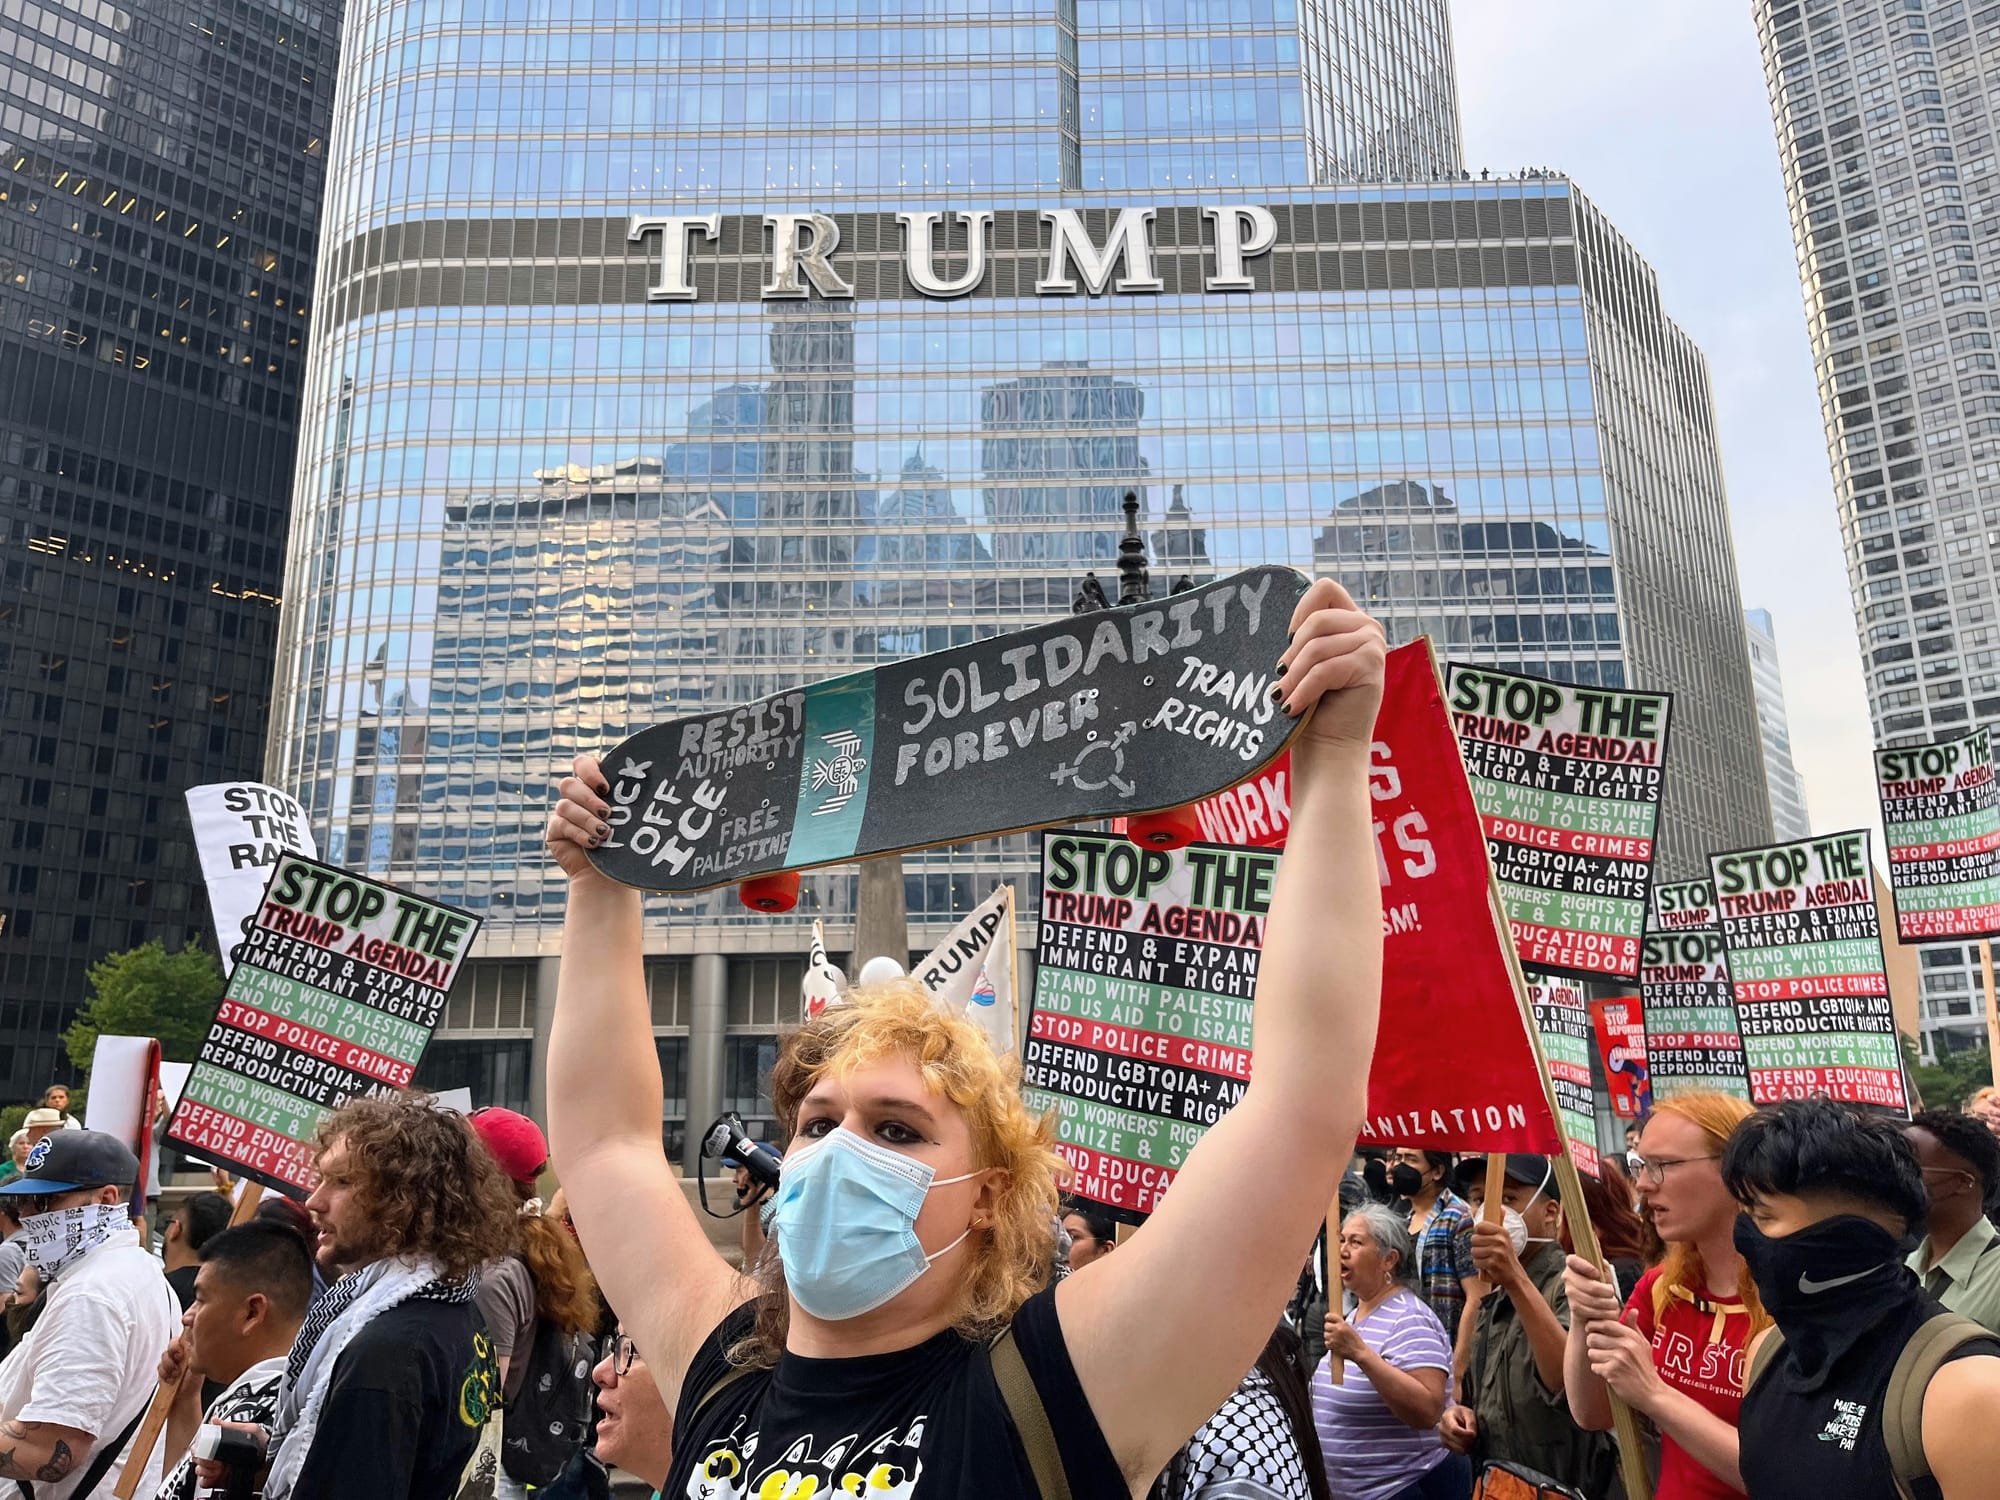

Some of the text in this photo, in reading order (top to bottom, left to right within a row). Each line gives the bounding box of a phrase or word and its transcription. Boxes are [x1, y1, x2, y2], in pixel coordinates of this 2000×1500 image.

[627, 206, 1278, 301] TRUMP
[903, 573, 1272, 734] SOLIDARITY
[1176, 656, 1278, 725] TRANS
[1452, 671, 1660, 739] STOP THE
[678, 693, 806, 757] RESIST
[895, 688, 1099, 786] FOREVER
[1154, 698, 1263, 761] RIGHTS
[1537, 727, 1656, 763] AGENDA!
[675, 734, 801, 780] AUTHORITY
[801, 756, 811, 799] HABITAT
[1460, 740, 1660, 785] EFEND & EXPAND
[224, 787, 298, 821] STOP
[1504, 787, 1652, 820] WITH PALESTINE
[1574, 778, 1658, 801] RIGHTS
[242, 815, 301, 849] THE
[630, 779, 682, 855] OFF
[651, 779, 728, 876] ICE
[720, 805, 780, 846] FREE
[1481, 798, 1650, 837] US AID TO ISRAEL
[692, 832, 792, 878] PALESTINE
[1492, 820, 1649, 858] POLICE CRIMES
[1048, 836, 1272, 914] STOP THE
[1507, 845, 1599, 874] LGBTQIA+
[1605, 861, 1648, 879] AND
[1716, 836, 1864, 892] STOP THE
[1560, 894, 1642, 918] RIGHTS TO
[1572, 875, 1645, 898] RIGHTS
[1720, 879, 1869, 915] TRUMP AGENDA!
[271, 861, 469, 961] STOP THE
[1043, 891, 1263, 947] TRUMP AGENDA
[1560, 910, 1640, 935] STRIKE
[1660, 909, 1710, 927] TRUMP
[1723, 904, 1876, 934] DEFEND EXPAND
[259, 902, 452, 987] TRUMP AGENDA!
[1042, 924, 1256, 974] DEFEND & EXPAN
[1510, 923, 1637, 955] DUCATION &
[1642, 934, 1720, 963] STOP
[1725, 921, 1878, 948] IMMIGRANT RIGHTS
[1731, 940, 1879, 965] STAND WITH PALESTINE
[249, 928, 446, 1010] DEFEND & EXPAND
[1040, 945, 1256, 997] IMMIGRANT RIGHT
[1531, 943, 1636, 972] FREEDOM
[1643, 966, 1706, 982] TRUMP
[1733, 957, 1881, 979] END ISRAEL
[235, 966, 427, 1046] STAND WITH PALESTINE
[242, 945, 439, 1027] IMMIGRANT RIGHTS
[1039, 970, 1253, 1024] STAND WITH PALESTIN
[1644, 983, 1706, 995] DEFEND
[1734, 977, 1885, 998] STOP POLICE CRIMES
[229, 982, 419, 1063] END US AID TO ISRAEL
[1037, 990, 1250, 1046] END US AID TO ISRAE
[1605, 1012, 1628, 1025] STOP
[1737, 998, 1865, 1018] DEFEND LGBTQIA+
[1740, 1017, 1891, 1034] REPRODUCTIVE RIGHTS
[218, 1001, 412, 1084] STOP POLICE CRIMES
[1032, 1014, 1082, 1041] STOP
[1093, 1026, 1168, 1059] POLICE
[1744, 1036, 1795, 1051] DEFEND
[193, 1063, 247, 1094] DEFEND
[200, 1042, 328, 1102] REPRODUCTIVE
[208, 1024, 278, 1062] DEFEND
[281, 1050, 365, 1093] LGBTQIA+
[1028, 1041, 1246, 1105] DEFEND LGBTQIA+ AN
[1746, 1051, 1897, 1066] UNIONIZE STRIKE
[1750, 1070, 1887, 1086] DEFEND EDUCATION
[186, 1081, 280, 1127] UNIONIZE
[286, 1118, 301, 1135] &
[1024, 1064, 1172, 1114] REPRODUCTIVE
[1856, 1087, 1903, 1103] FREEDOM
[177, 1101, 246, 1140] DEFEND
[1083, 1103, 1165, 1139] WORKERS'
[168, 1118, 320, 1189] ACADEMIC FREE
[1138, 1138, 1151, 1160] &
